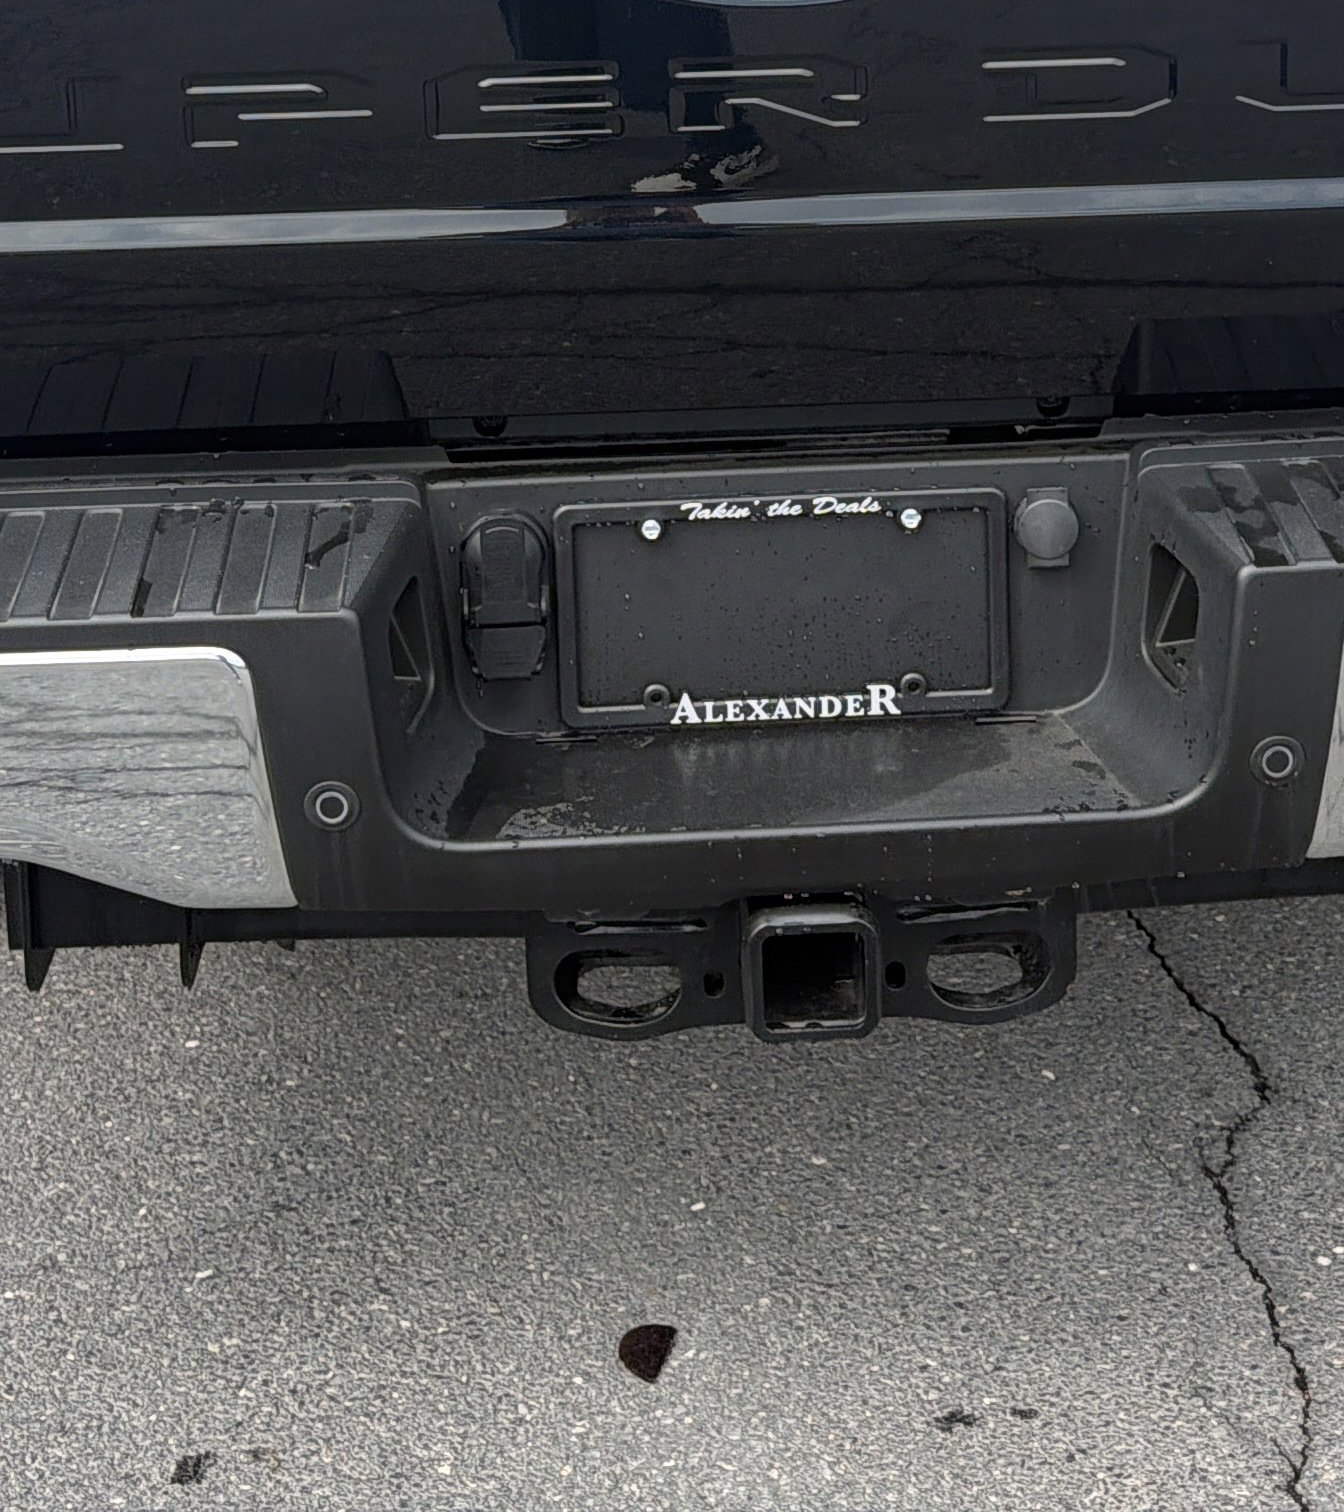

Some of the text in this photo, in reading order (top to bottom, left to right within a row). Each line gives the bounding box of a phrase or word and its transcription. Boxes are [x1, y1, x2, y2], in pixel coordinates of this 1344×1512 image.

[680, 496, 883, 522] Takin' the Deals
[670, 684, 902, 726] ALEXANDER
